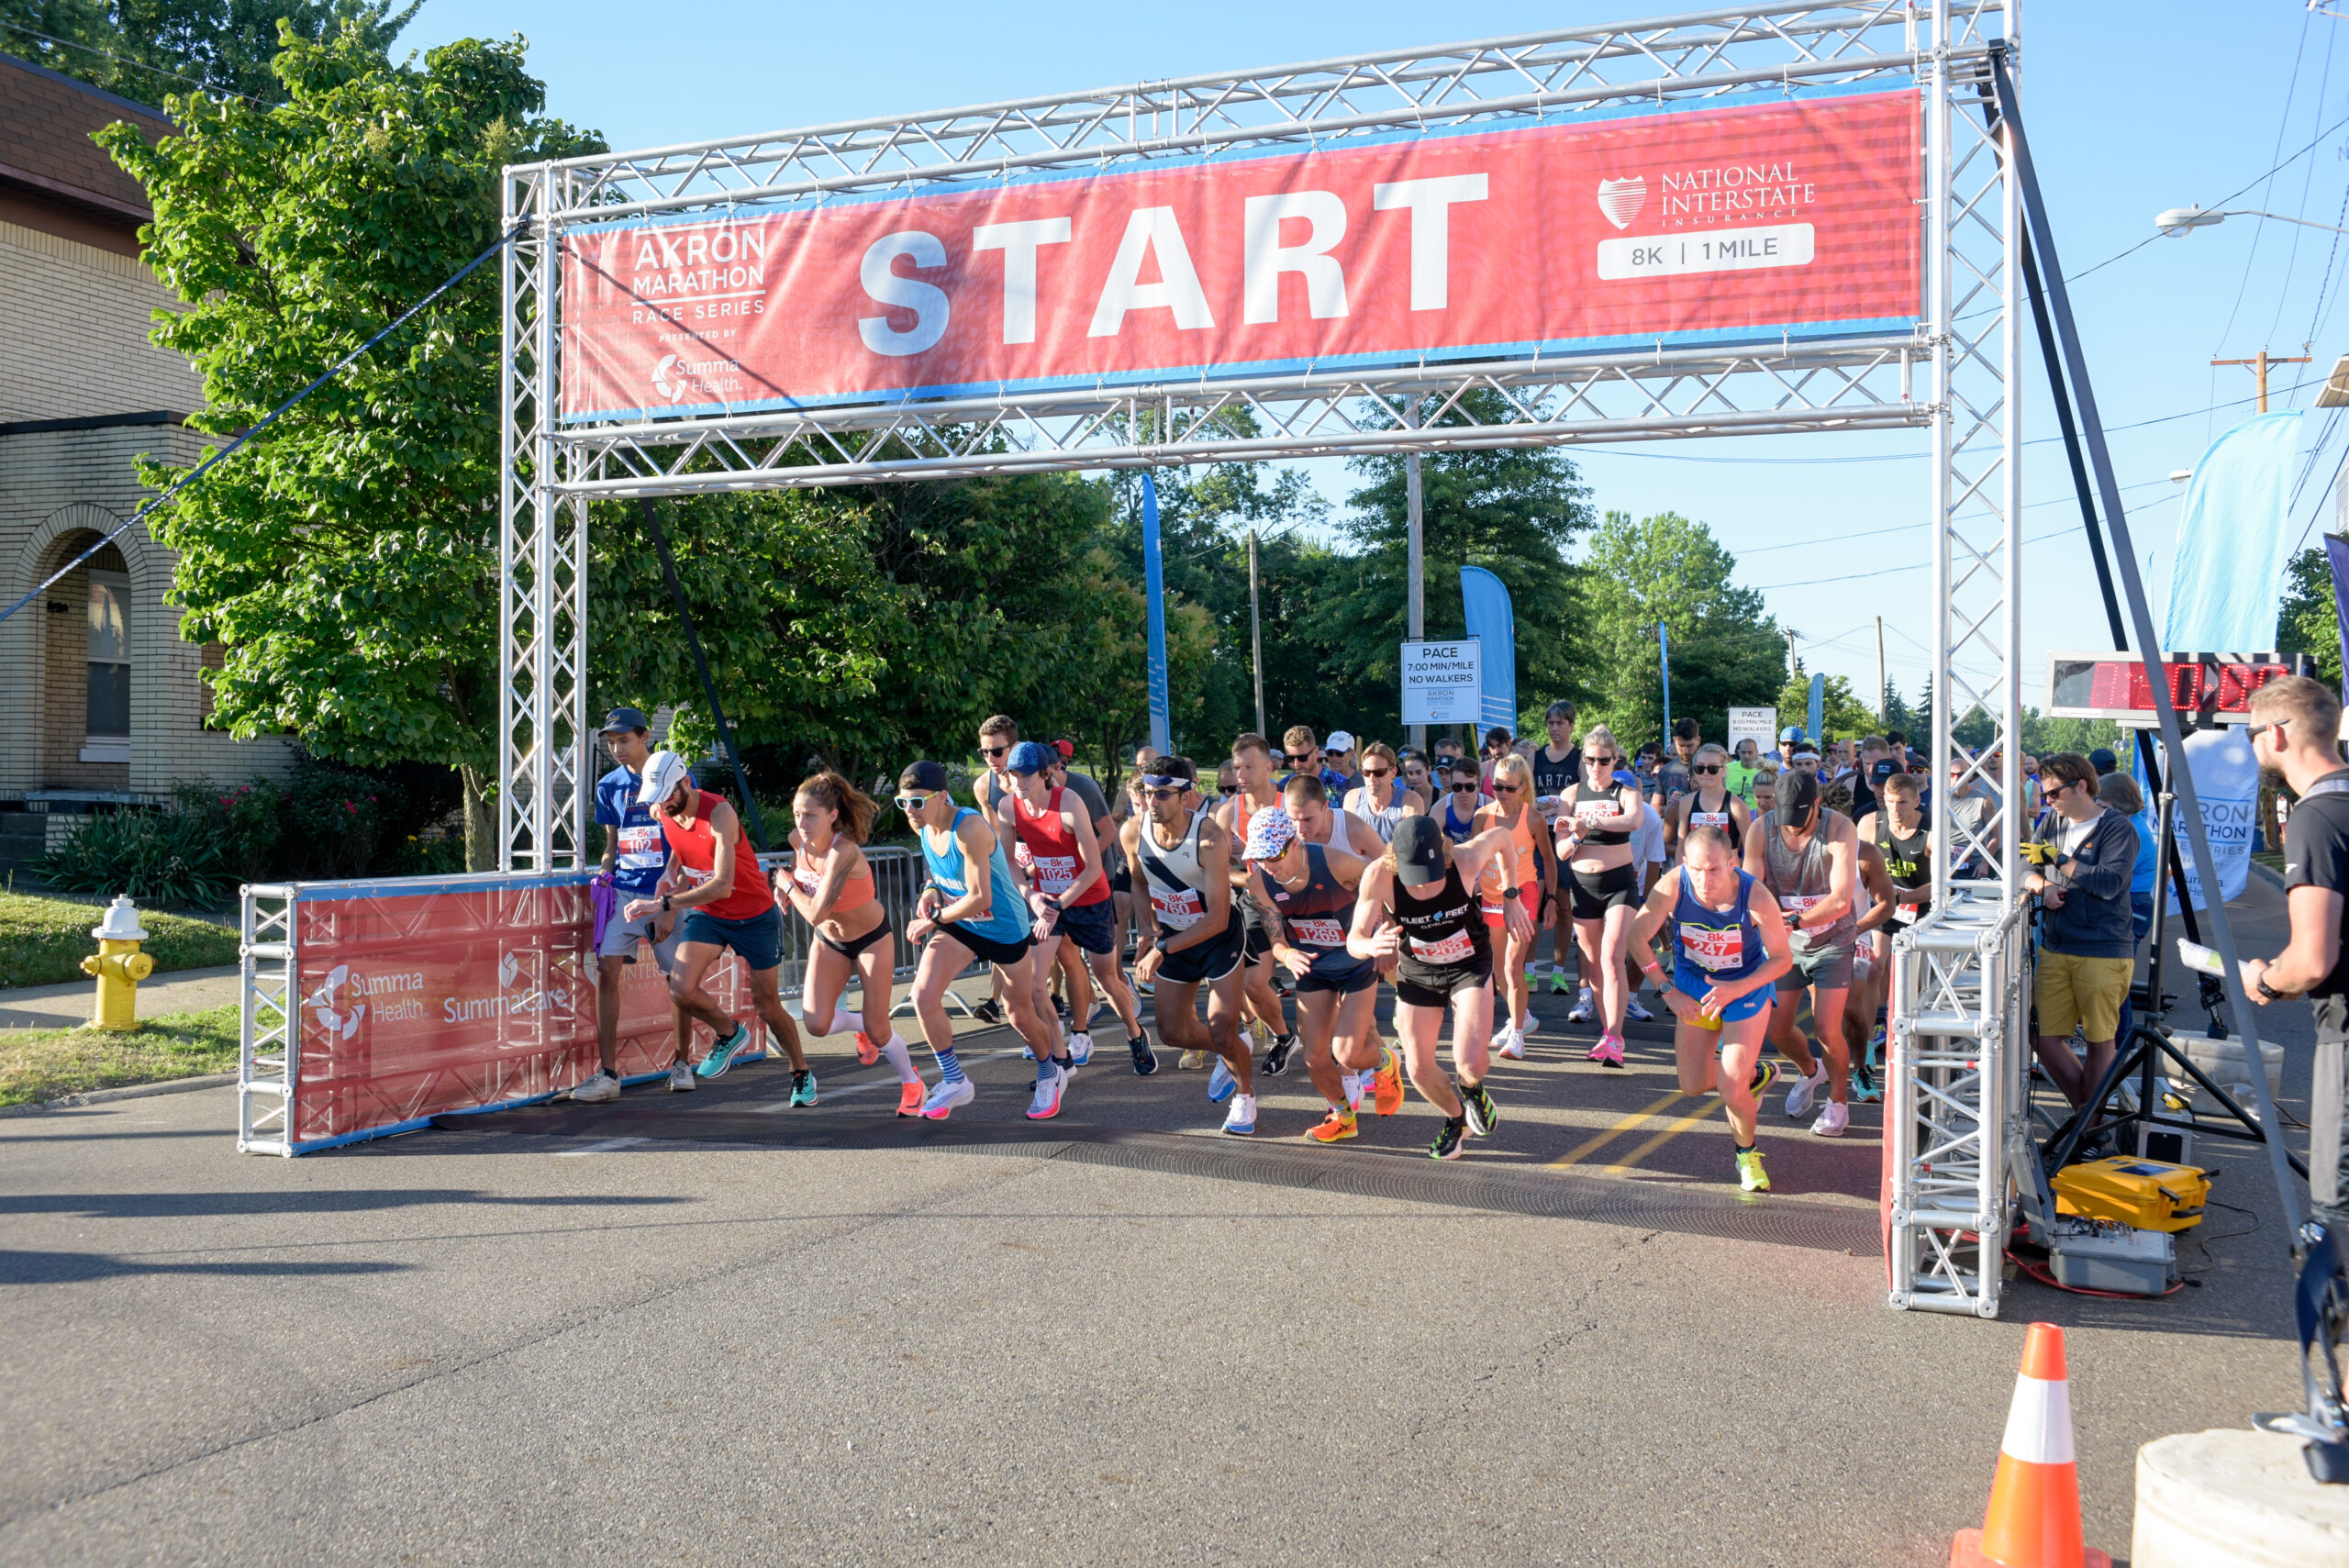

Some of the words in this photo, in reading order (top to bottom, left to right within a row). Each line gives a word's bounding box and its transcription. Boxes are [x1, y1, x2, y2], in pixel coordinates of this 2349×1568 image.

[1661, 161, 1798, 193] NATIONAL
[1662, 183, 1815, 216] INTERSTATE
[1662, 208, 1797, 228] INSURANCE
[634, 228, 765, 272] AKRON
[1631, 247, 1663, 266] 8K
[1719, 237, 1778, 259] MILE
[858, 172, 1488, 357] START
[633, 264, 764, 296] MARATHON
[632, 306, 684, 324] RACE
[696, 299, 764, 319] SERIES
[659, 330, 718, 343] PRESENTED
[723, 329, 737, 339] BY
[676, 359, 740, 375] Summa
[692, 376, 739, 394] Health
[1423, 647, 1458, 659] PACE
[1408, 662, 1429, 672] 7:00
[1430, 661, 1475, 672] MIN/MILE
[1409, 675, 1423, 684] NO
[1425, 673, 1474, 684] WALKERS
[1427, 689, 1454, 697] AKRON
[1538, 774, 1572, 786] ARTC
[1596, 802, 1607, 810] 8k
[1707, 814, 1718, 822] 8k
[638, 828, 650, 838] 8k
[628, 839, 653, 854] 102
[1051, 859, 1063, 867] 8k
[1040, 868, 1073, 881] 1025
[1168, 894, 1184, 903] 8k
[1803, 896, 1817, 907] 8k
[1160, 900, 1190, 915] 760
[1400, 915, 1431, 925] FLEET
[1445, 904, 1468, 917] FEET
[1420, 919, 1454, 929] CLEVELAND
[1300, 928, 1340, 942] 1269
[1708, 932, 1725, 941] 8k
[1419, 942, 1464, 956] 1209
[1692, 940, 1728, 956] 247
[351, 973, 423, 997] Summa
[373, 998, 424, 1024] Health
[444, 987, 568, 1023] SummaCare
